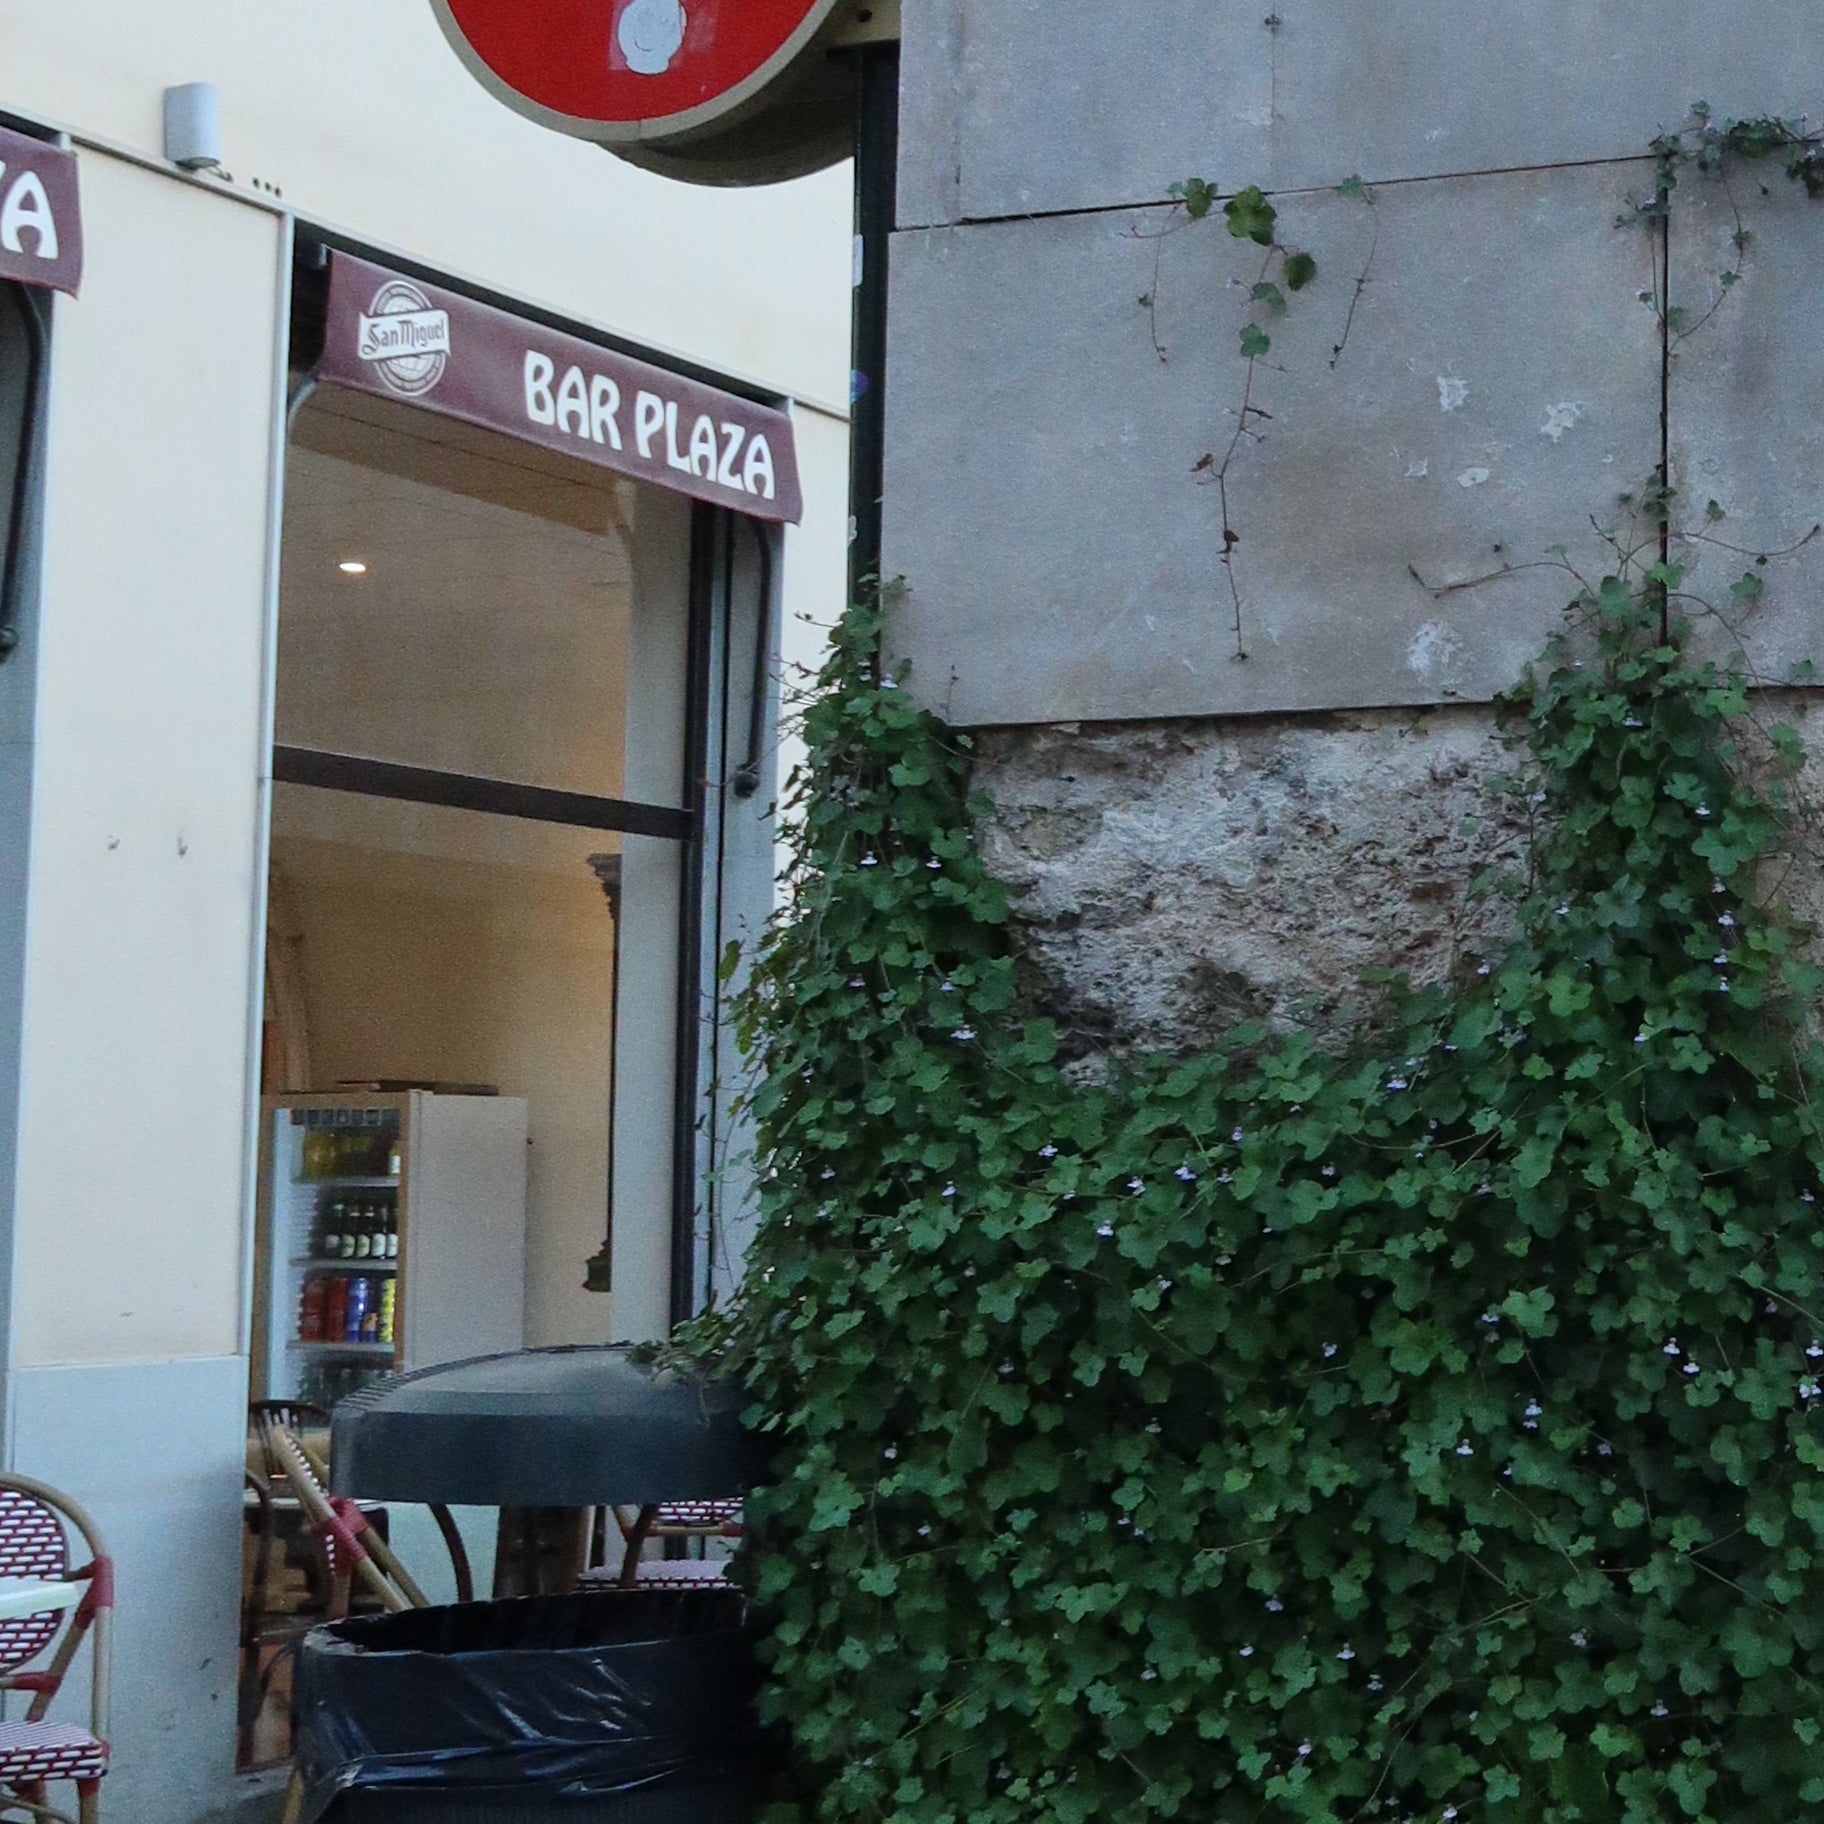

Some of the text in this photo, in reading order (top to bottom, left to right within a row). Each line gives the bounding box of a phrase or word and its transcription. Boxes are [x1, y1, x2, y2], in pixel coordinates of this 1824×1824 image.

[0, 160, 58, 260] A
[362, 318, 445, 355] San Miguel
[524, 349, 775, 500] BAR PLAZA
